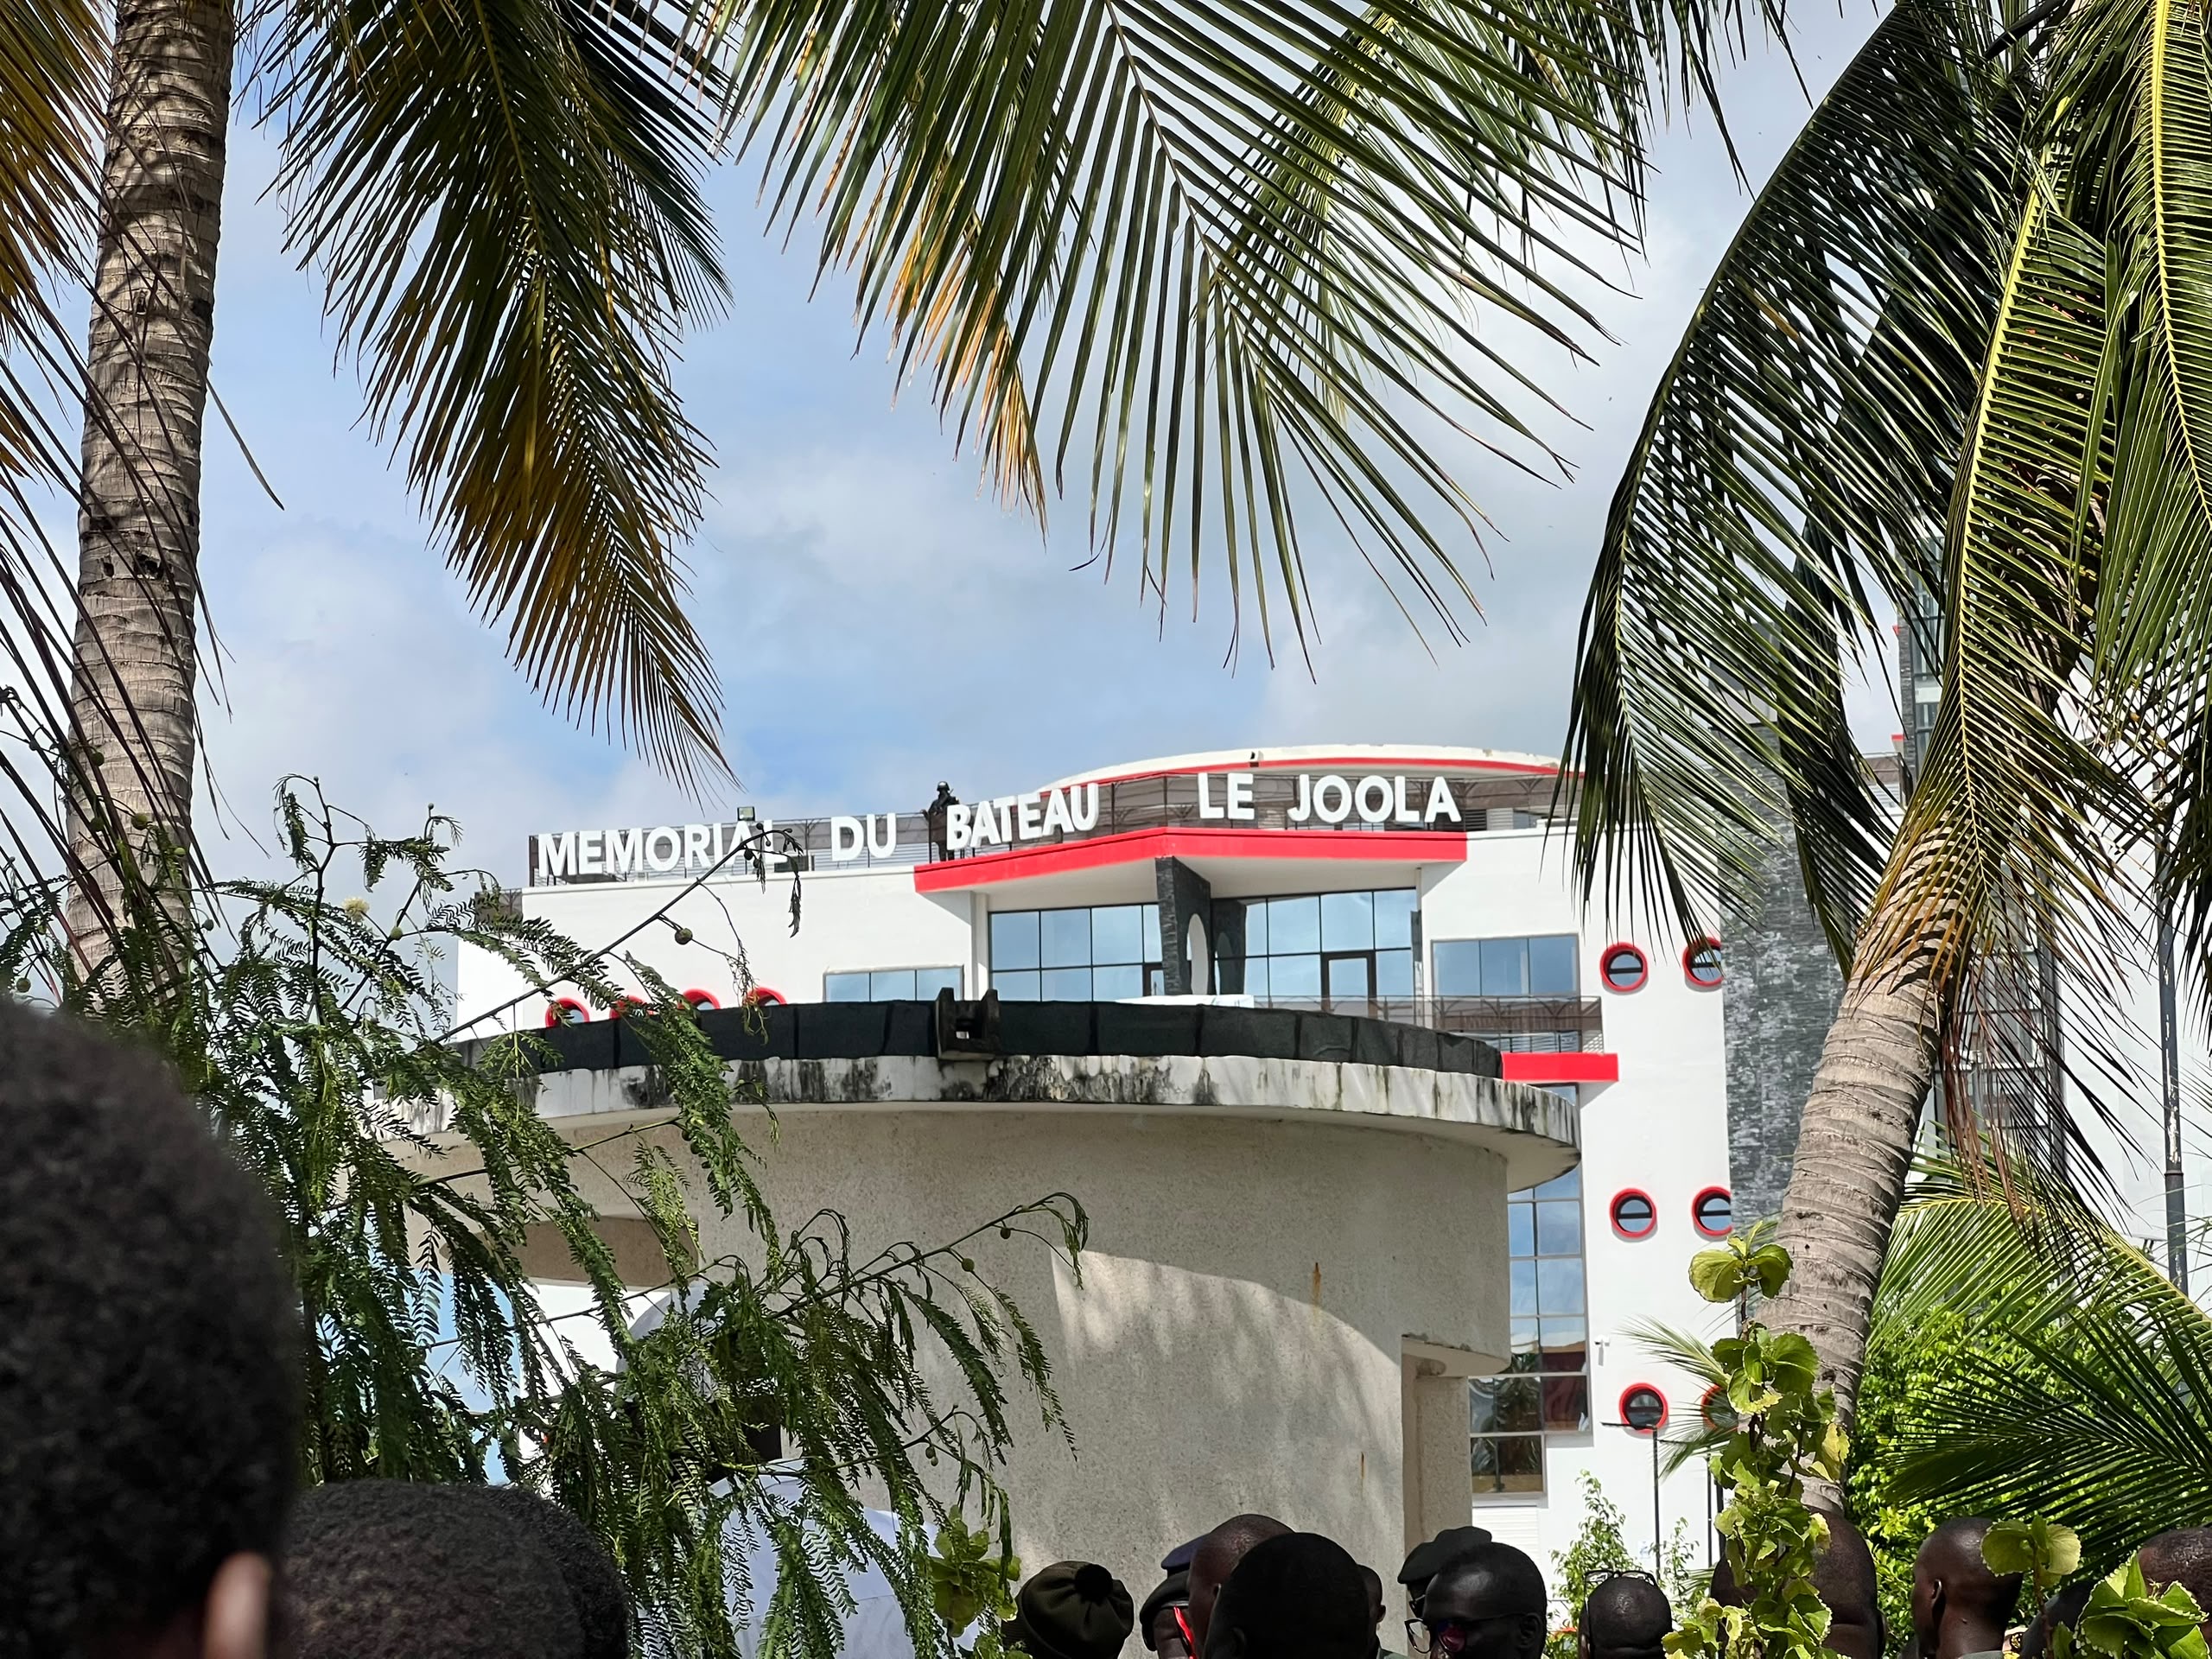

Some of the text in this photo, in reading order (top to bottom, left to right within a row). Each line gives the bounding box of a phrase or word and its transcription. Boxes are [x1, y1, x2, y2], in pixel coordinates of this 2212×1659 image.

[537, 772, 1462, 877] MEMORIAL DU BATEAU LE JOOLA
